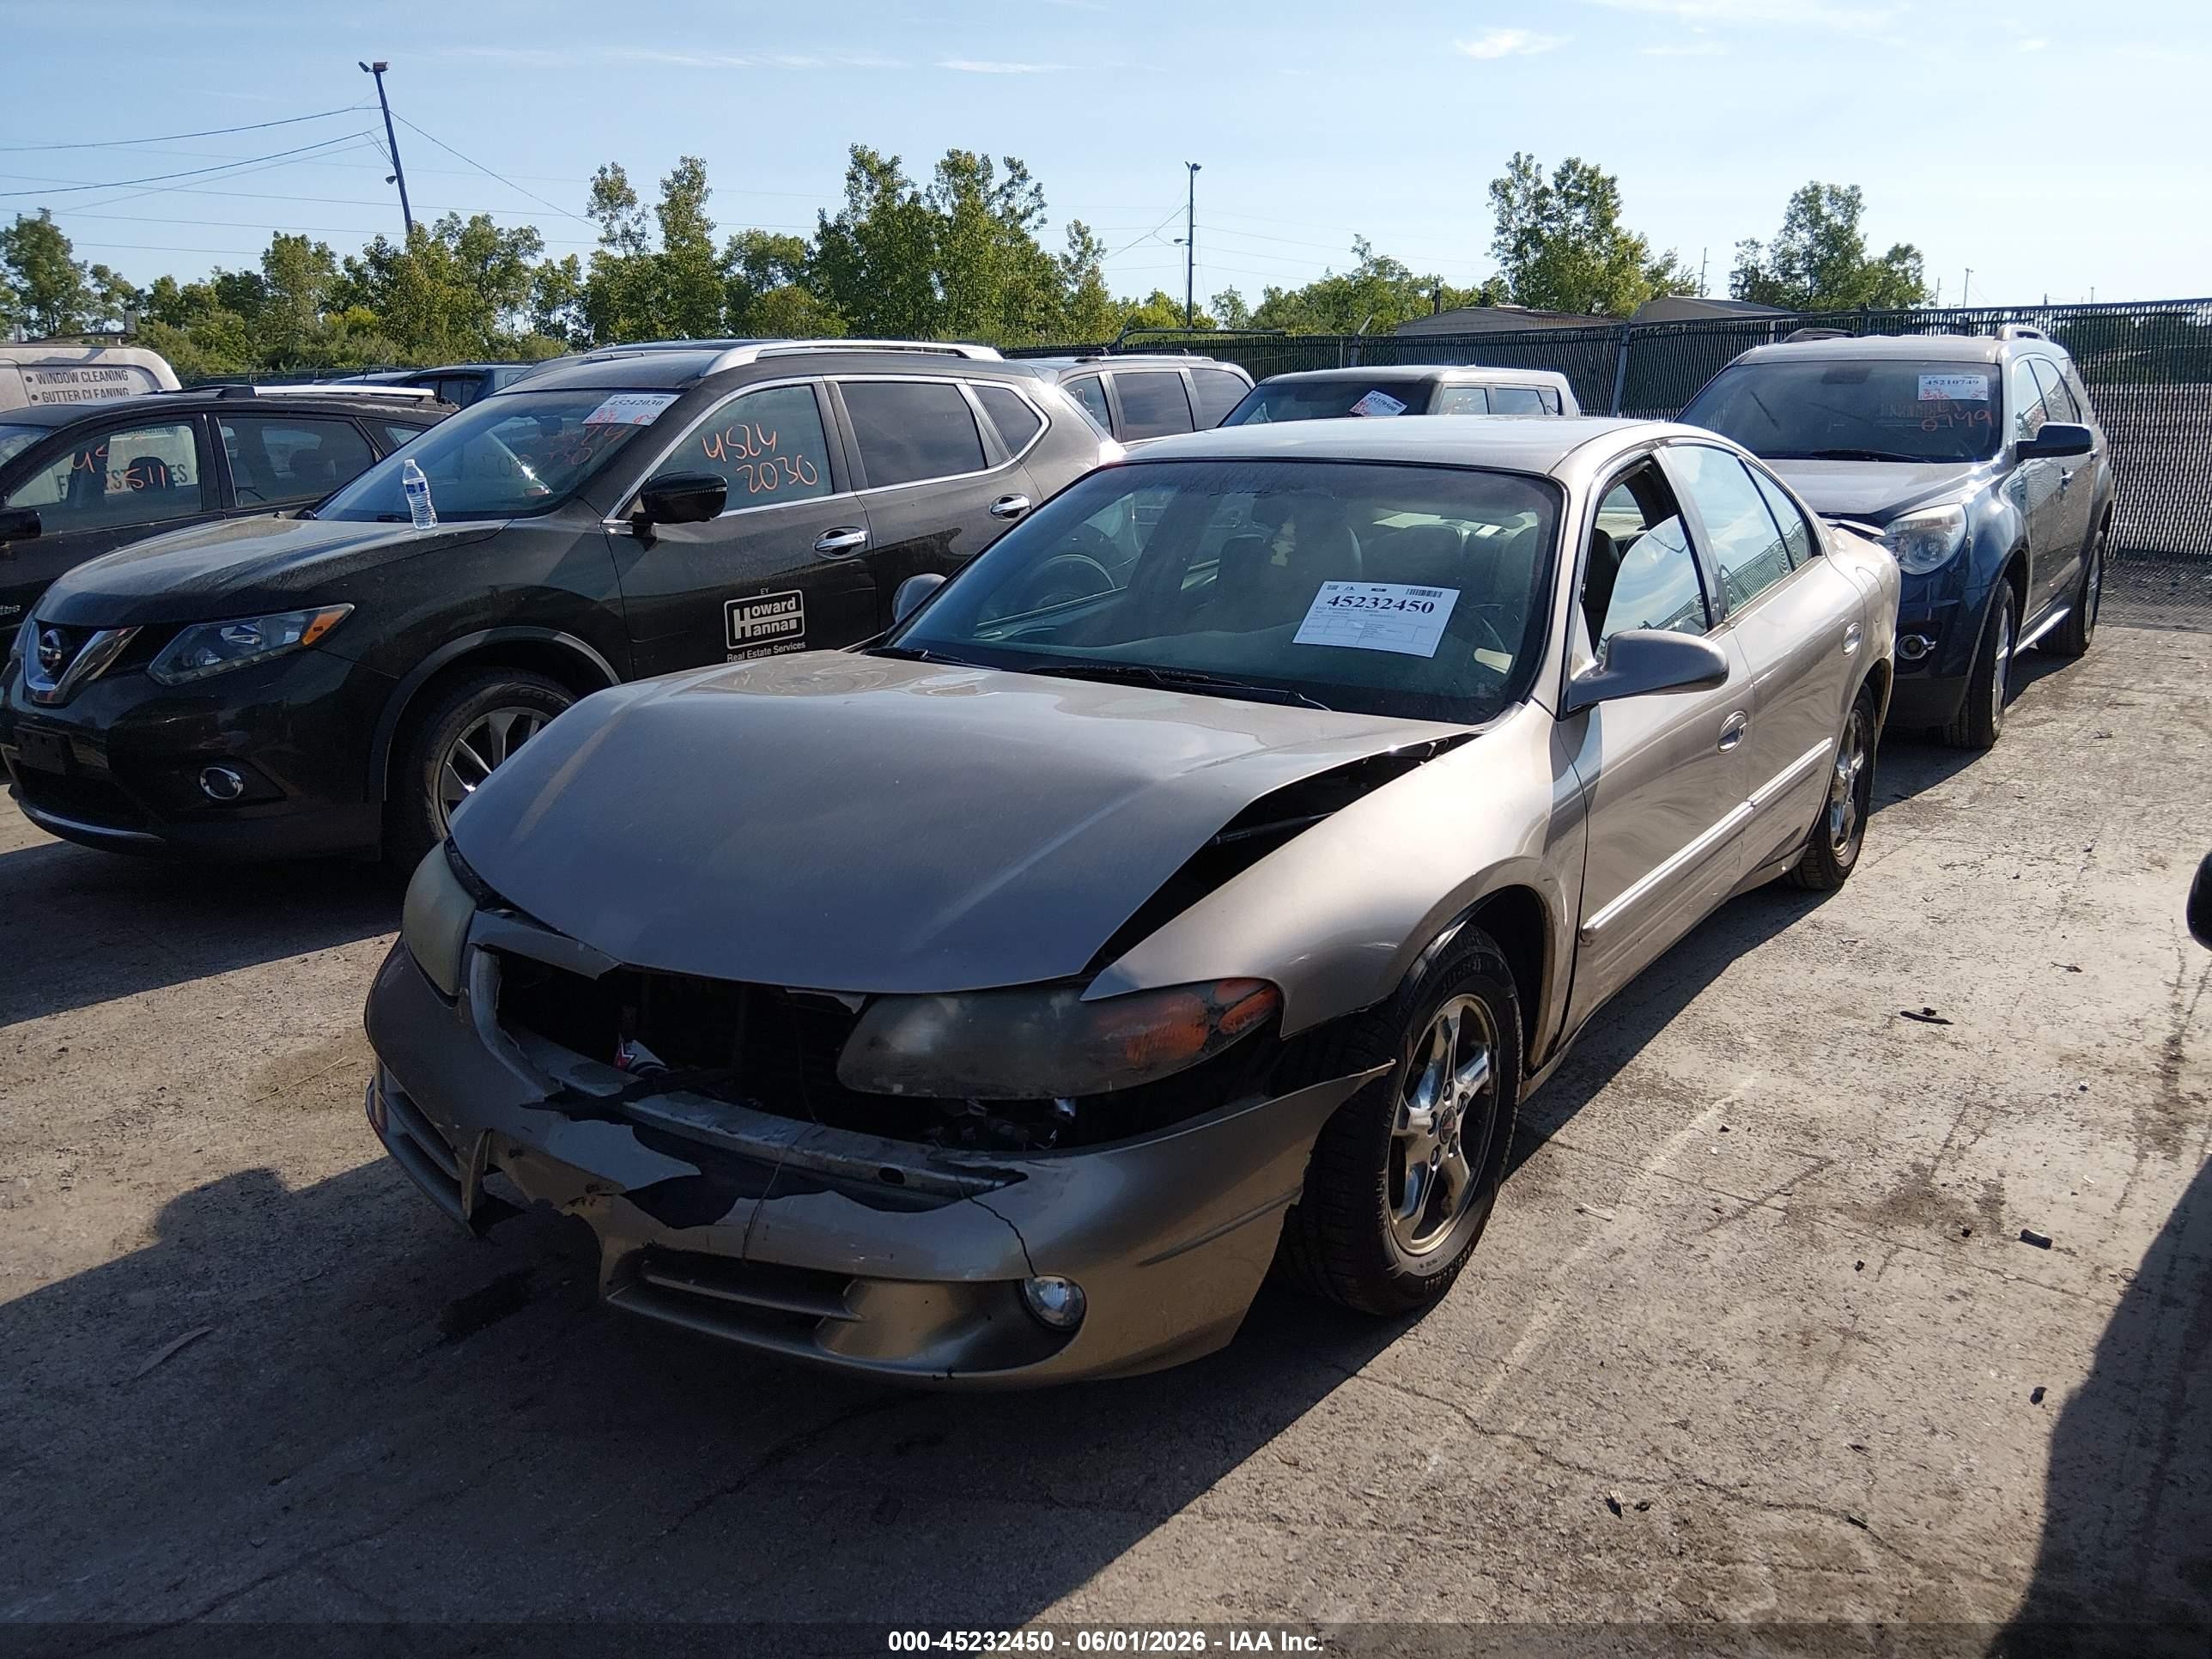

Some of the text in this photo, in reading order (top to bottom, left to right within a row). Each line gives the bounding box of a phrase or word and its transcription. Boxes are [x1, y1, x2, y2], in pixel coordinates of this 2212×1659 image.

[35, 369, 129, 385] WINDOW CLEANING
[41, 390, 81, 403] GUTTER
[736, 454, 817, 494] 2030
[733, 596, 797, 621] Howard
[1327, 594, 1435, 614] 45232450
[727, 641, 806, 662] Real Estate Services
